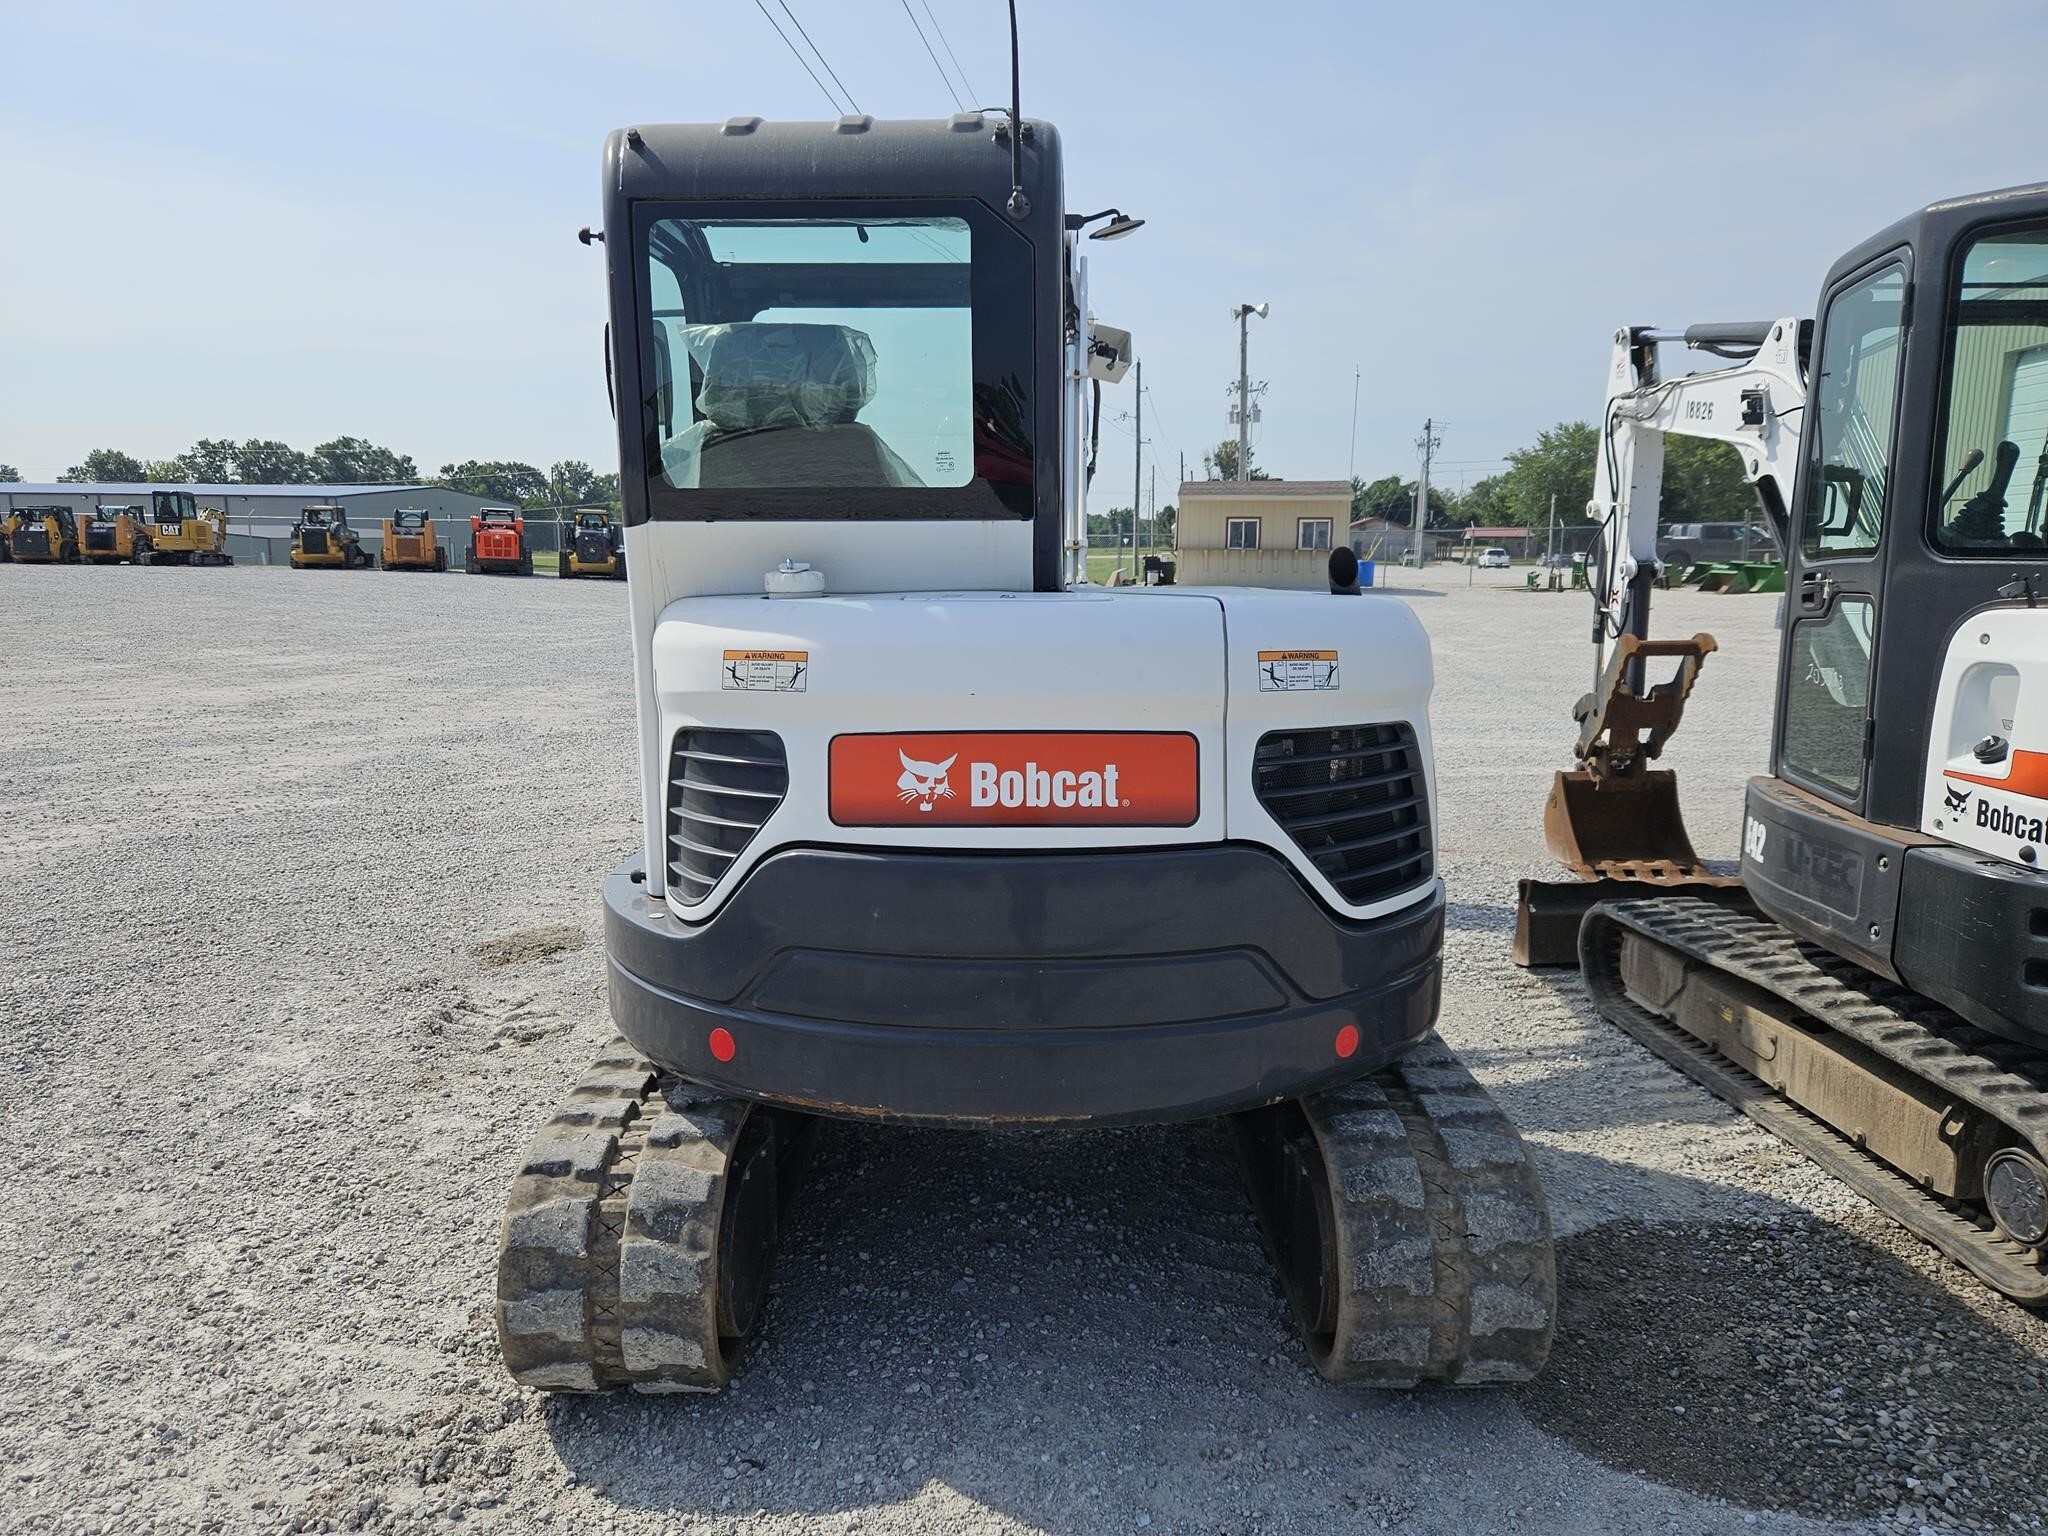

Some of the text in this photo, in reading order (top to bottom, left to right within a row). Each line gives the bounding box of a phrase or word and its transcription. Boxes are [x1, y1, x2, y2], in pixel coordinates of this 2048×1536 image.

[1685, 400, 1714, 421] 18826
[162, 525, 180, 535] CAT
[751, 652, 785, 660] WARNING
[1287, 652, 1320, 660] WARNING
[970, 762, 1118, 808] Bobcat
